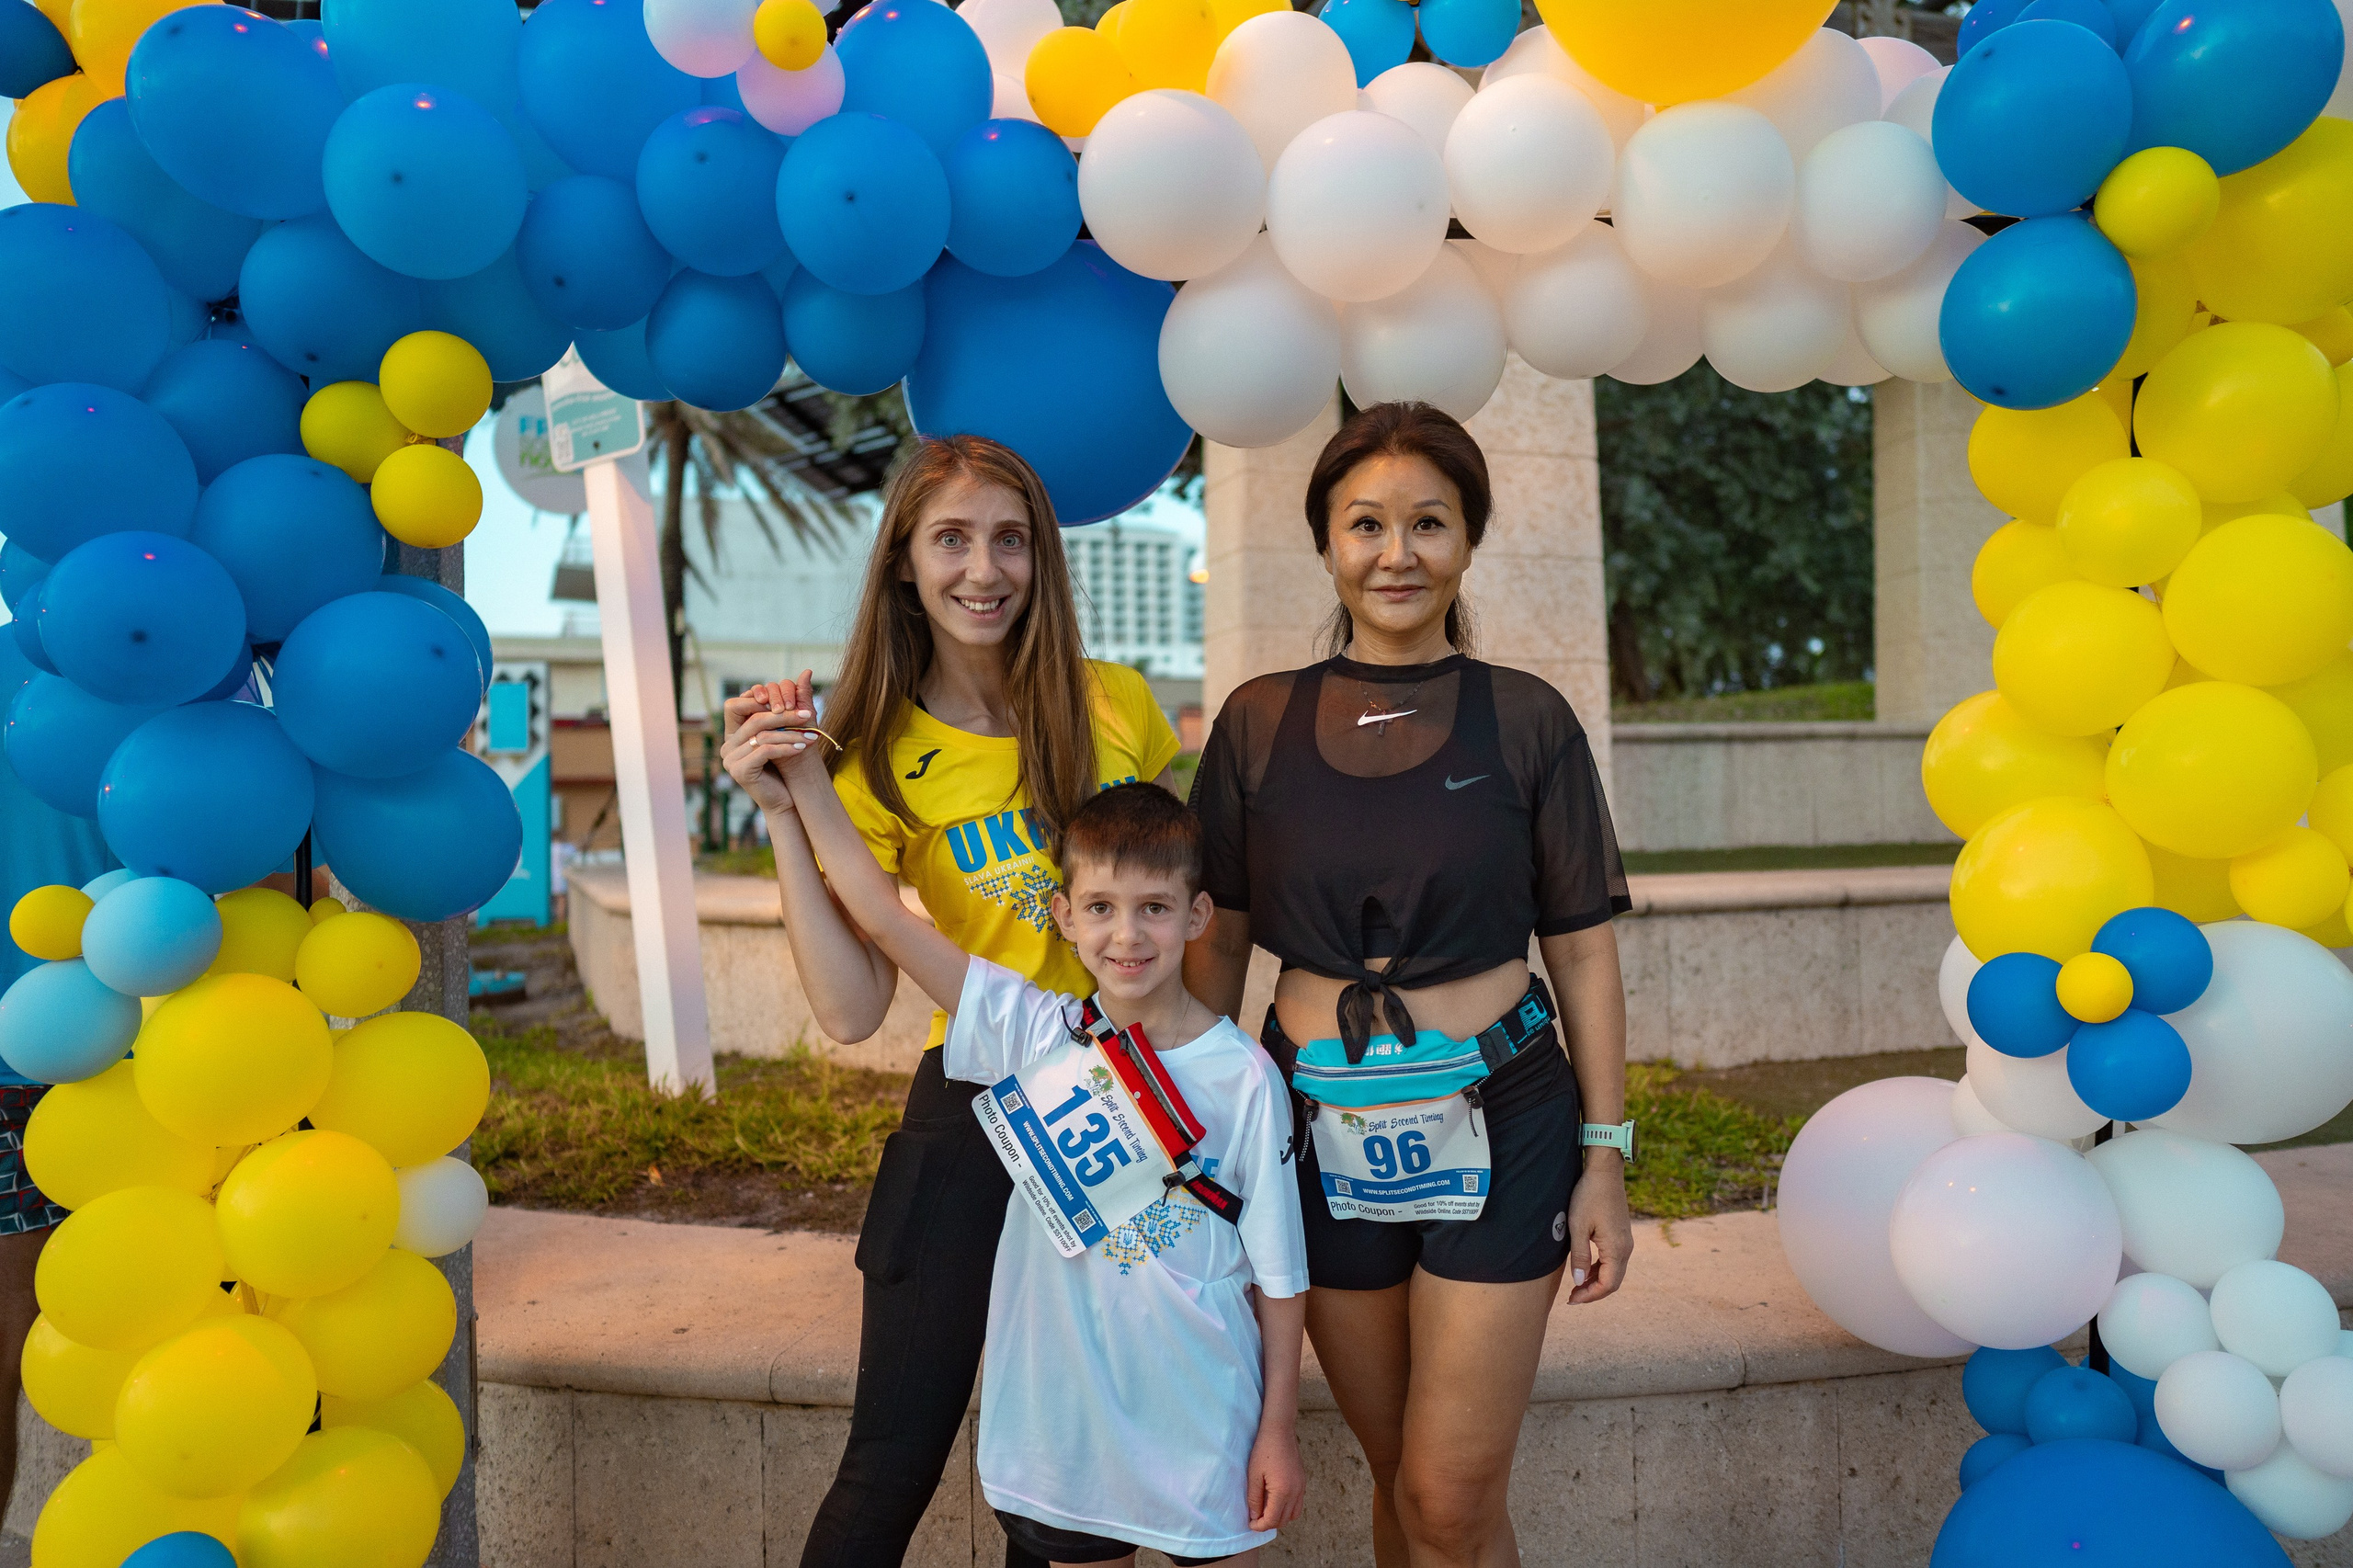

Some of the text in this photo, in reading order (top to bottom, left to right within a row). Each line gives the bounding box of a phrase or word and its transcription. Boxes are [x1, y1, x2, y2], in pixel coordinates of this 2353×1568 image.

[963, 856, 1035, 886] SLAVA UKRAINI!
[979, 1094, 998, 1124] Photo
[995, 1124, 1020, 1163] Coupon
[1042, 1085, 1132, 1187] 135
[1100, 1095, 1148, 1164] Split Second Timing
[1369, 1113, 1444, 1132] Split Second Timing
[1022, 1120, 1074, 1201] WWW.SPLITSECONDTIMING.COM
[1362, 1131, 1431, 1180] 96
[1022, 1179, 1038, 1201] Wildside
[1045, 1216, 1055, 1230] Code
[1029, 1176, 1040, 1189] Good
[1041, 1196, 1051, 1208] 10%
[1052, 1214, 1065, 1231] events
[1063, 1230, 1074, 1244] shot
[1070, 1240, 1077, 1248] by
[1330, 1201, 1356, 1212] Photo
[1358, 1204, 1395, 1217] Coupon
[1362, 1179, 1451, 1196] WWW.SPLITSECONDTIMING.COM
